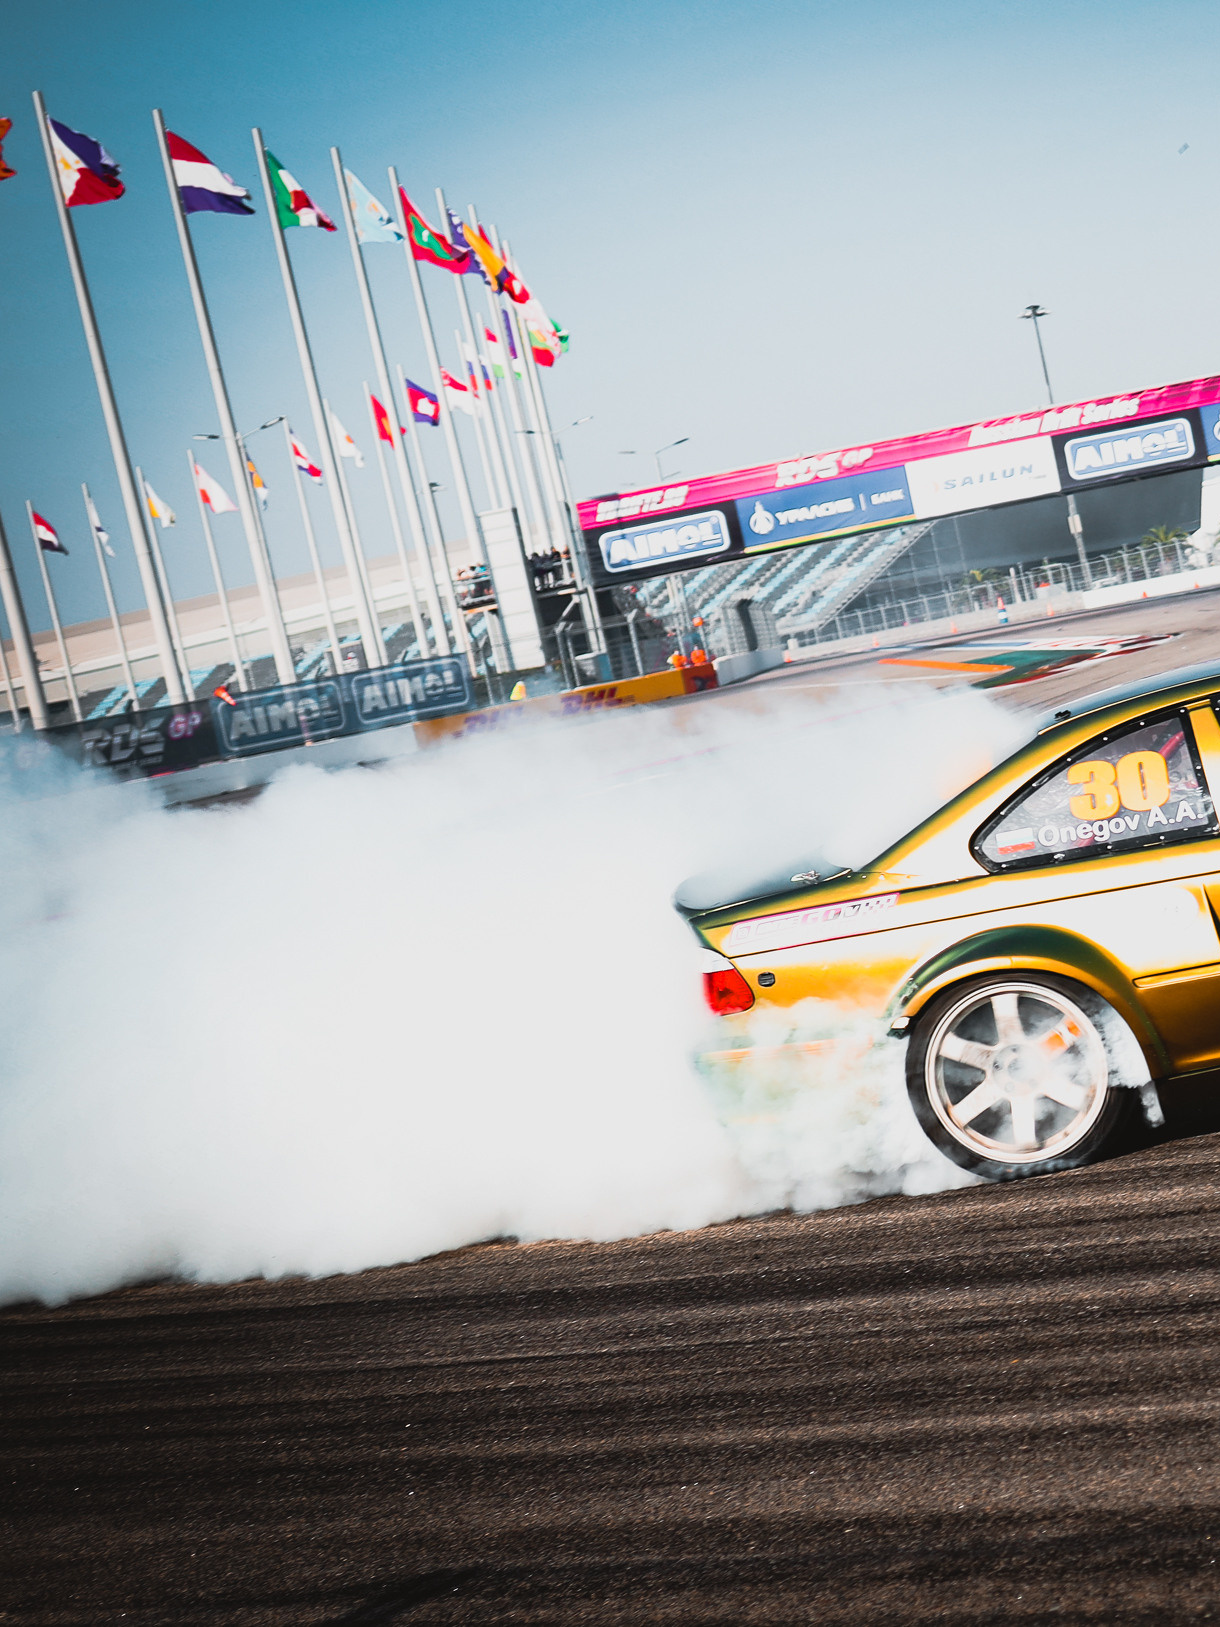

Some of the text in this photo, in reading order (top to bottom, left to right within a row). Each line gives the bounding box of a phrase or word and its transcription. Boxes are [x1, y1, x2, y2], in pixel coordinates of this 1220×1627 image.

[775, 451, 843, 488] RDS
[1074, 426, 1188, 472] AIMOL
[944, 464, 1034, 490] SAILUN
[610, 518, 723, 565] AIMOL
[363, 668, 464, 714] AIMOL
[82, 715, 165, 768] RDS
[168, 712, 201, 740] GP
[230, 693, 339, 741] AIMOL
[1067, 750, 1171, 821] 30
[1037, 799, 1204, 848] Onegov A.A.
